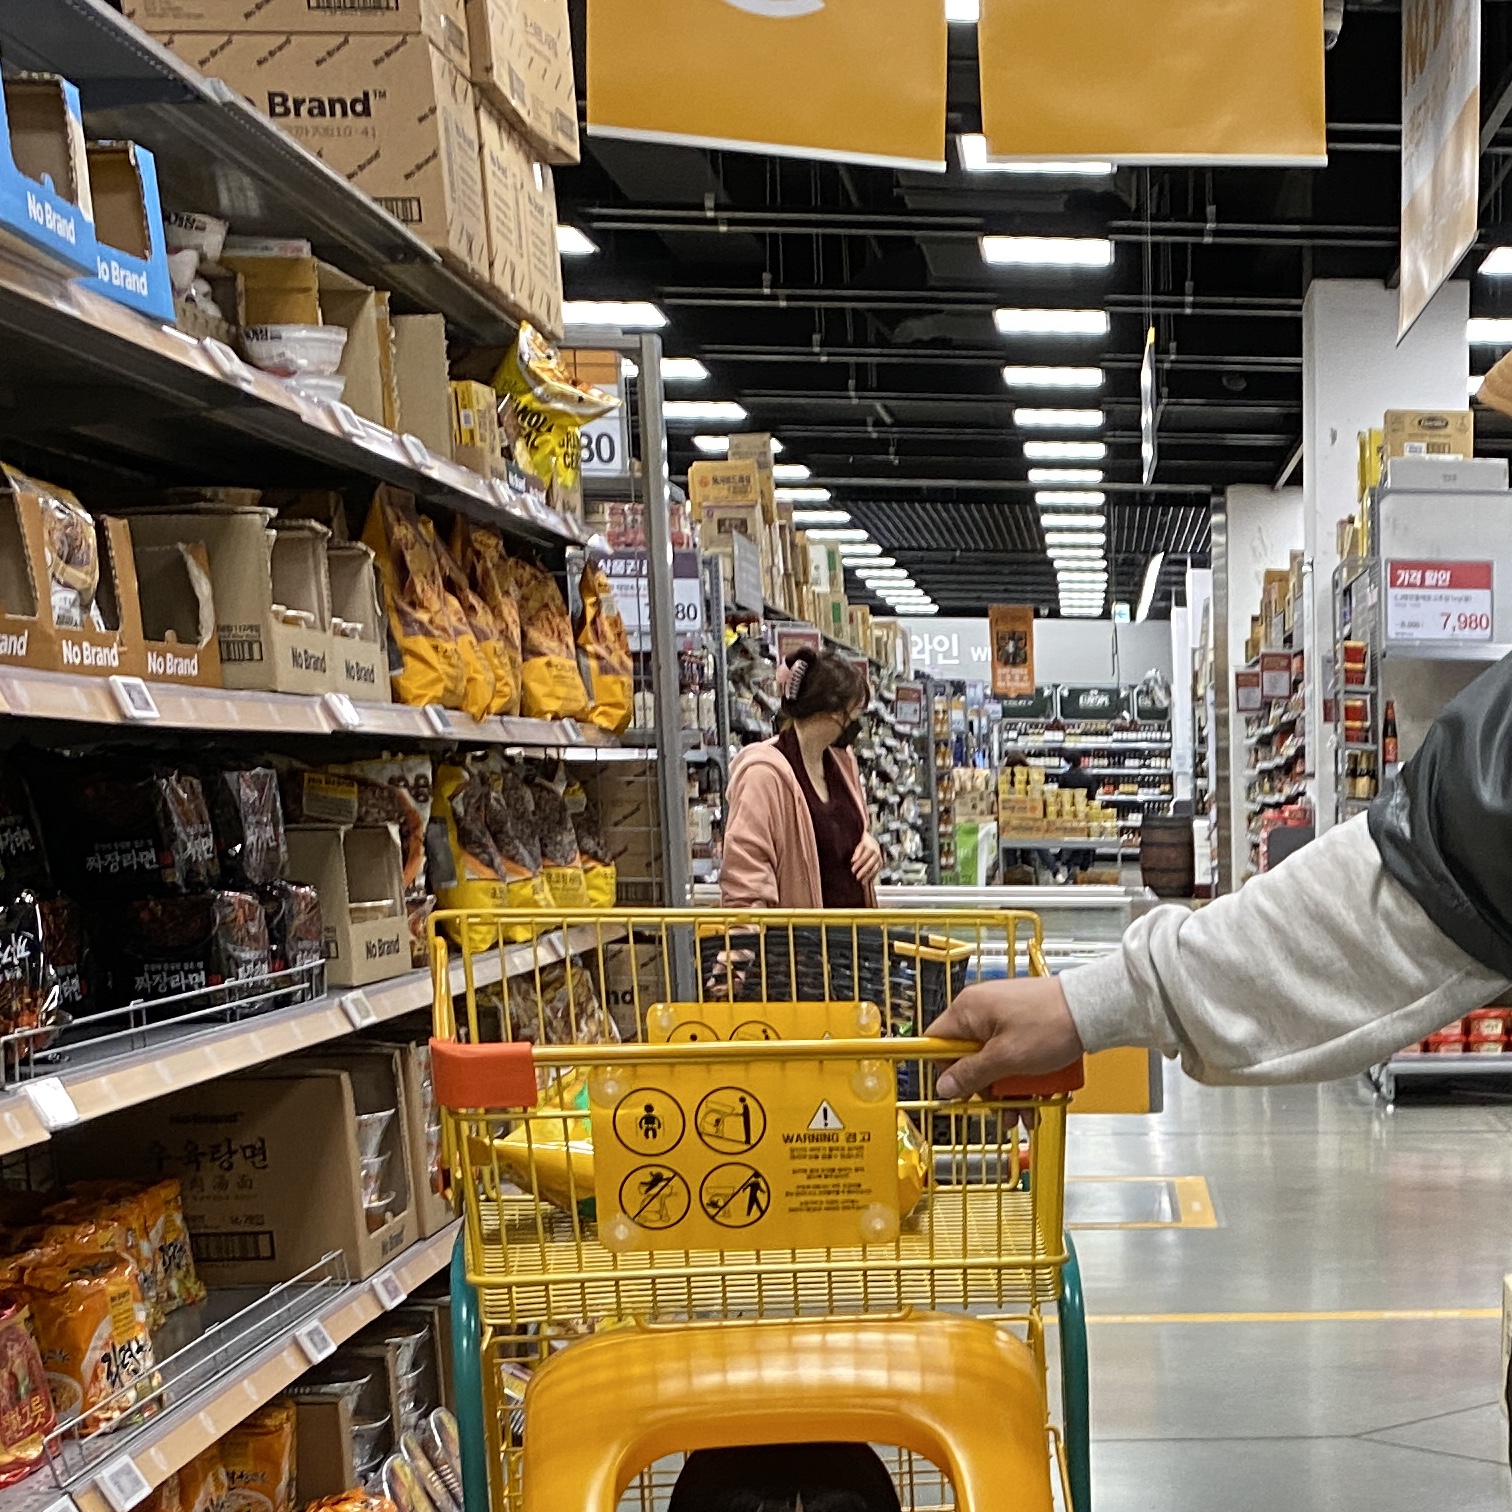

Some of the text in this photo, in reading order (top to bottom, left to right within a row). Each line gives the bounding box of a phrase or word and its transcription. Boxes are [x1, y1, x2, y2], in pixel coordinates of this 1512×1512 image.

[267, 90, 372, 118] Brand
[26, 190, 76, 245] No Brand
[111, 259, 148, 297] Brand
[1396, 569, 1452, 588] 가격 할인
[1440, 612, 1490, 632] 7,980
[0, 629, 28, 657] and
[62, 639, 120, 669] No Brand
[147, 651, 199, 678] No Brand
[291, 647, 327, 675] No Brand
[345, 659, 375, 685] No Brand
[366, 933, 400, 960] No Brand
[782, 1132, 840, 1144] WARNING
